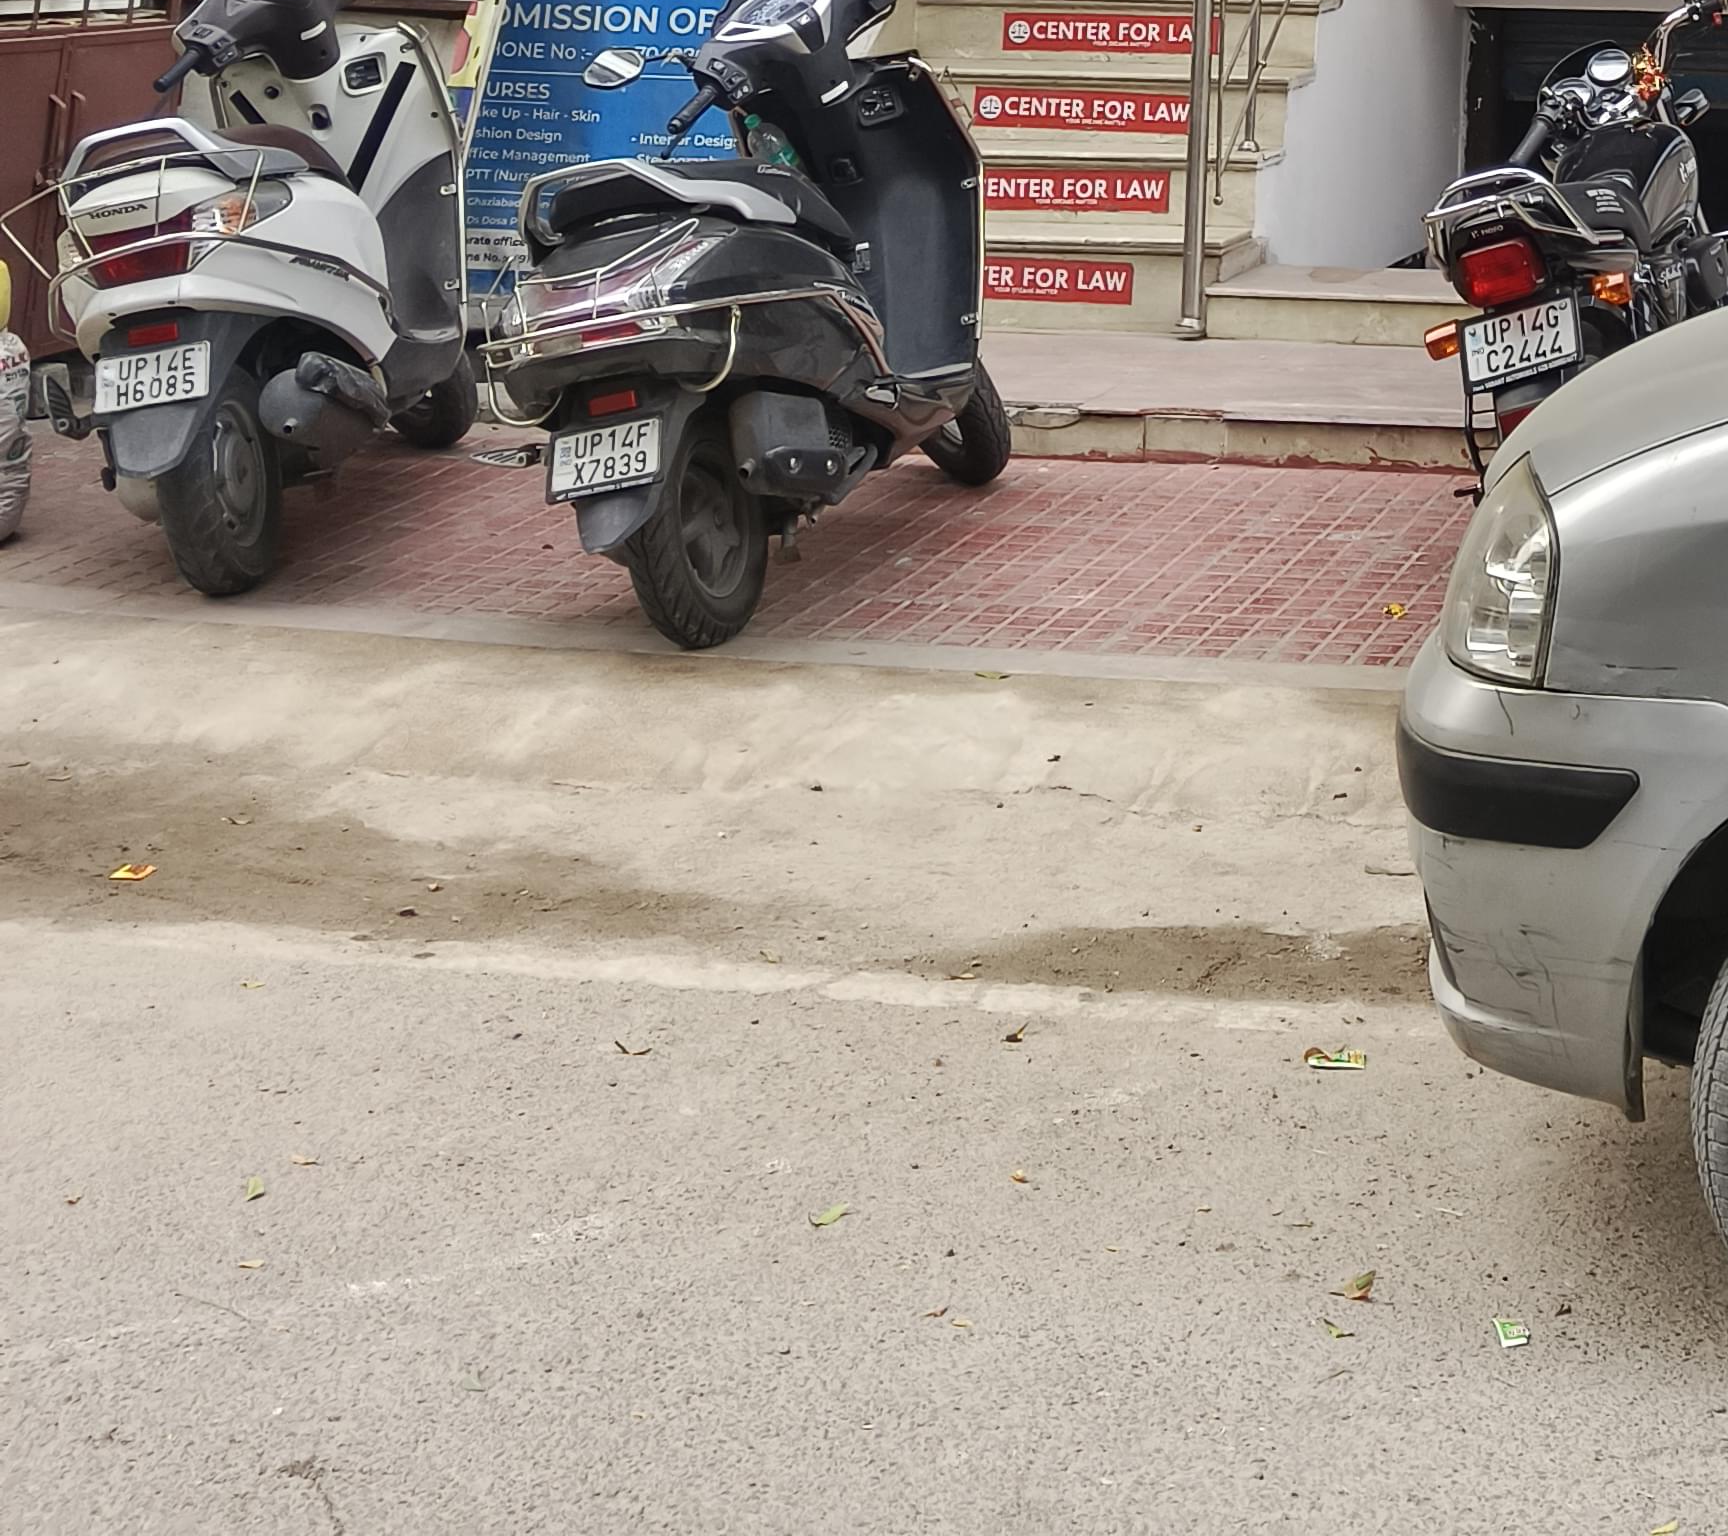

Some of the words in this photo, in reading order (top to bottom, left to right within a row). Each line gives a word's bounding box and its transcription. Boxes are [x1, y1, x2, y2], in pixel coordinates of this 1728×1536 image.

[1033, 21, 1111, 41] CENTER
[1118, 22, 1161, 42] FOR
[550, 43, 577, 60] No
[502, 109, 521, 123] Up
[532, 108, 561, 122] Hair
[571, 110, 601, 123] Skin
[1004, 96, 1085, 119] CENTER
[1093, 99, 1136, 121] FOR
[1144, 102, 1191, 123] LAW
[517, 129, 563, 142] Design
[502, 150, 591, 165] Management
[984, 178, 1055, 199] ENTER
[1062, 178, 1109, 200] FOR
[1116, 179, 1165, 200] LAW
[89, 203, 149, 220] HONDA
[1022, 267, 1069, 289] FOR
[1077, 269, 1127, 292] LAW
[1483, 305, 1560, 347] UP14G
[1486, 330, 1563, 373] C2444
[116, 371, 195, 407] H6085
[574, 422, 651, 459] UP14F
[572, 450, 647, 486] X7839
